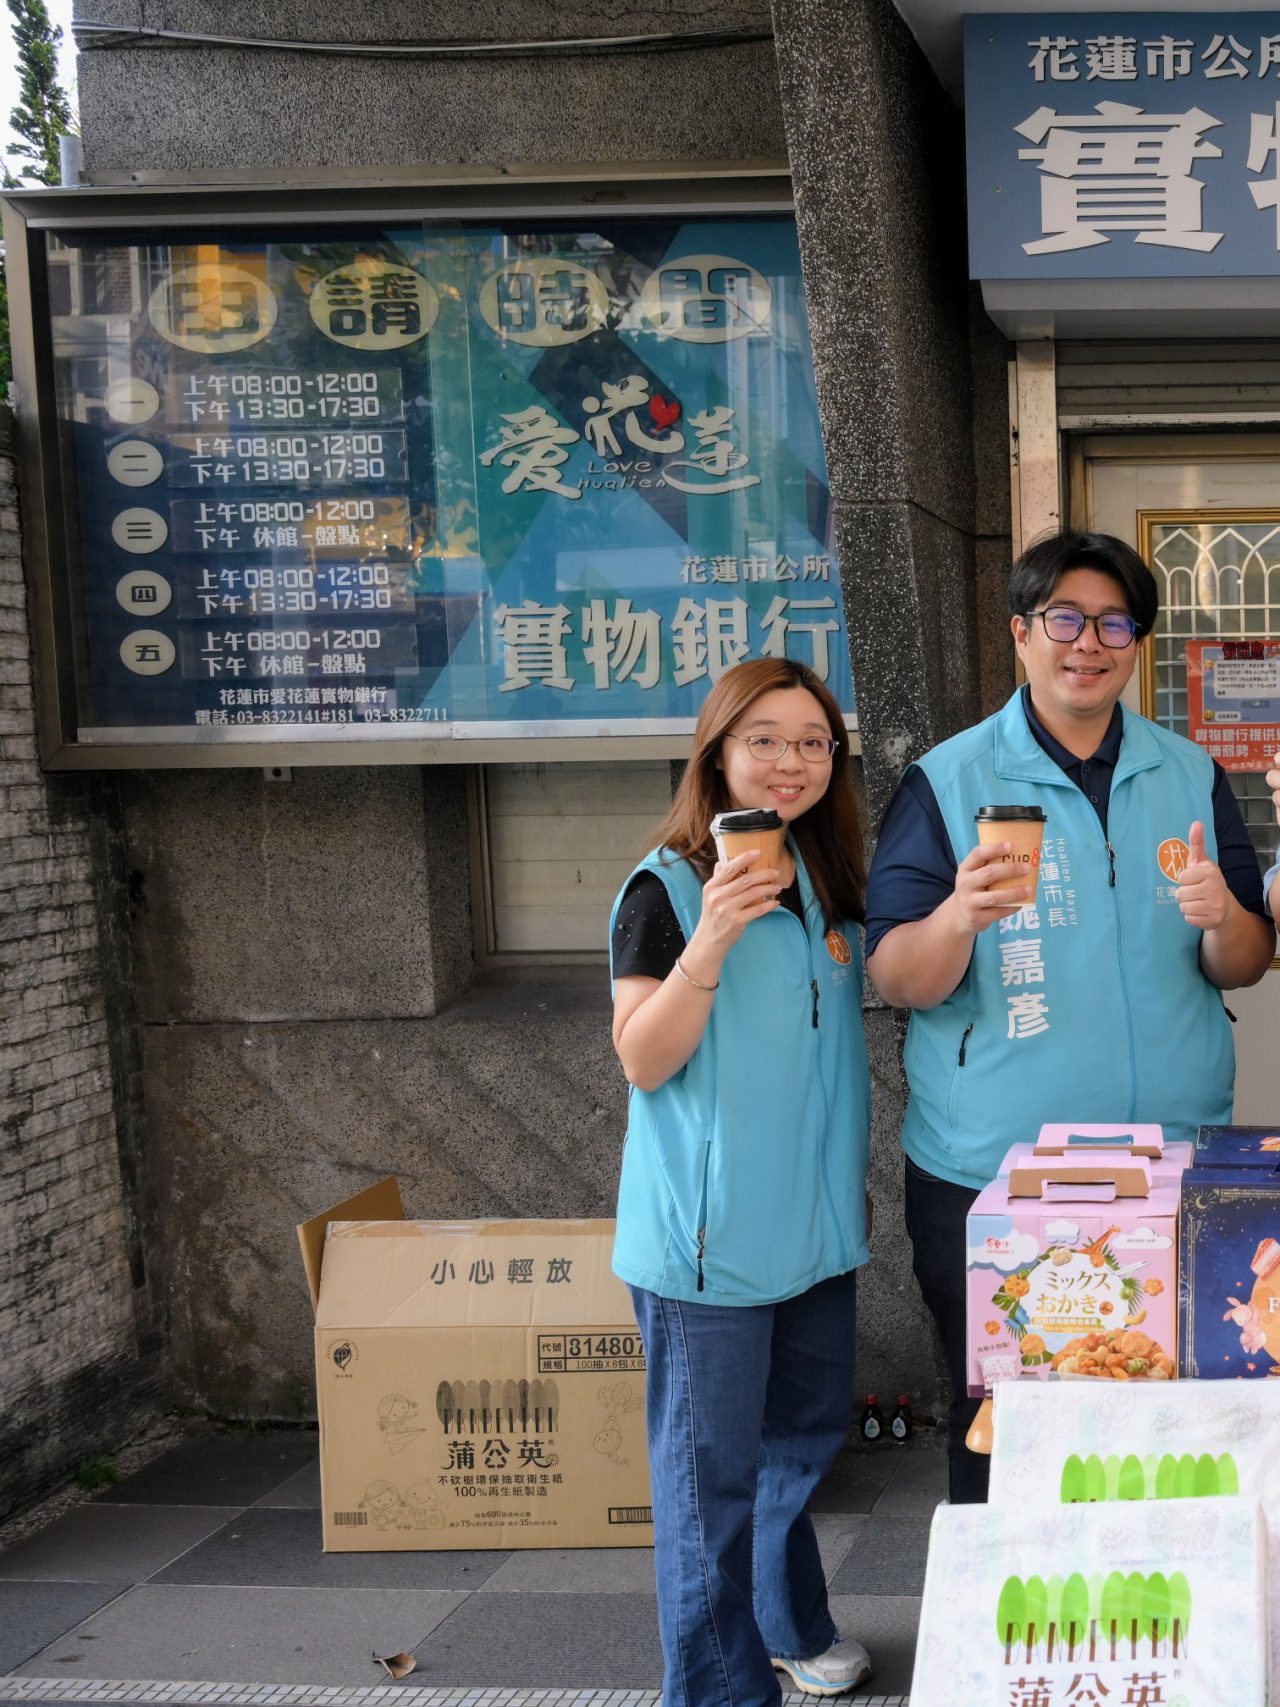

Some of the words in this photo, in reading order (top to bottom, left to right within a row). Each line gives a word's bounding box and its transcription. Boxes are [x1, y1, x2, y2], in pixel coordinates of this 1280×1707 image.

[168, 268, 752, 339] 申請時間
[480, 374, 760, 499] 愛花蓮
[588, 460, 652, 473] Love
[578, 476, 666, 489] Hualien
[195, 527, 241, 549] 下午
[680, 554, 831, 584] 花蓮市公所
[131, 586, 157, 603] 四
[135, 644, 161, 662] 五
[492, 595, 840, 692] 實物銀行
[202, 656, 247, 677] 下午
[219, 686, 387, 706] 花蓮市愛花蓮實物銀行
[364, 708, 448, 723] 03-8322711
[1039, 839, 1067, 927] 花蓮市長
[1056, 838, 1071, 882] Hualien
[1066, 890, 1077, 925] Mayor
[430, 1258, 573, 1285] 小心輕放
[1047, 1271, 1112, 1290] ミックス
[1036, 1294, 1099, 1314] おかき
[542, 1342, 562, 1352] 代號
[543, 1360, 563, 1370] 規格
[444, 1407, 559, 1434] DANDELION
[440, 1439, 553, 1470] 蒲公英
[438, 1474, 563, 1485] 不砍樹環保抽取衛生紙
[454, 1486, 548, 1497] 100%再生紙製造
[1005, 1618, 1189, 1665] DANDELION
[1009, 1671, 1168, 1707] 蒲公英
